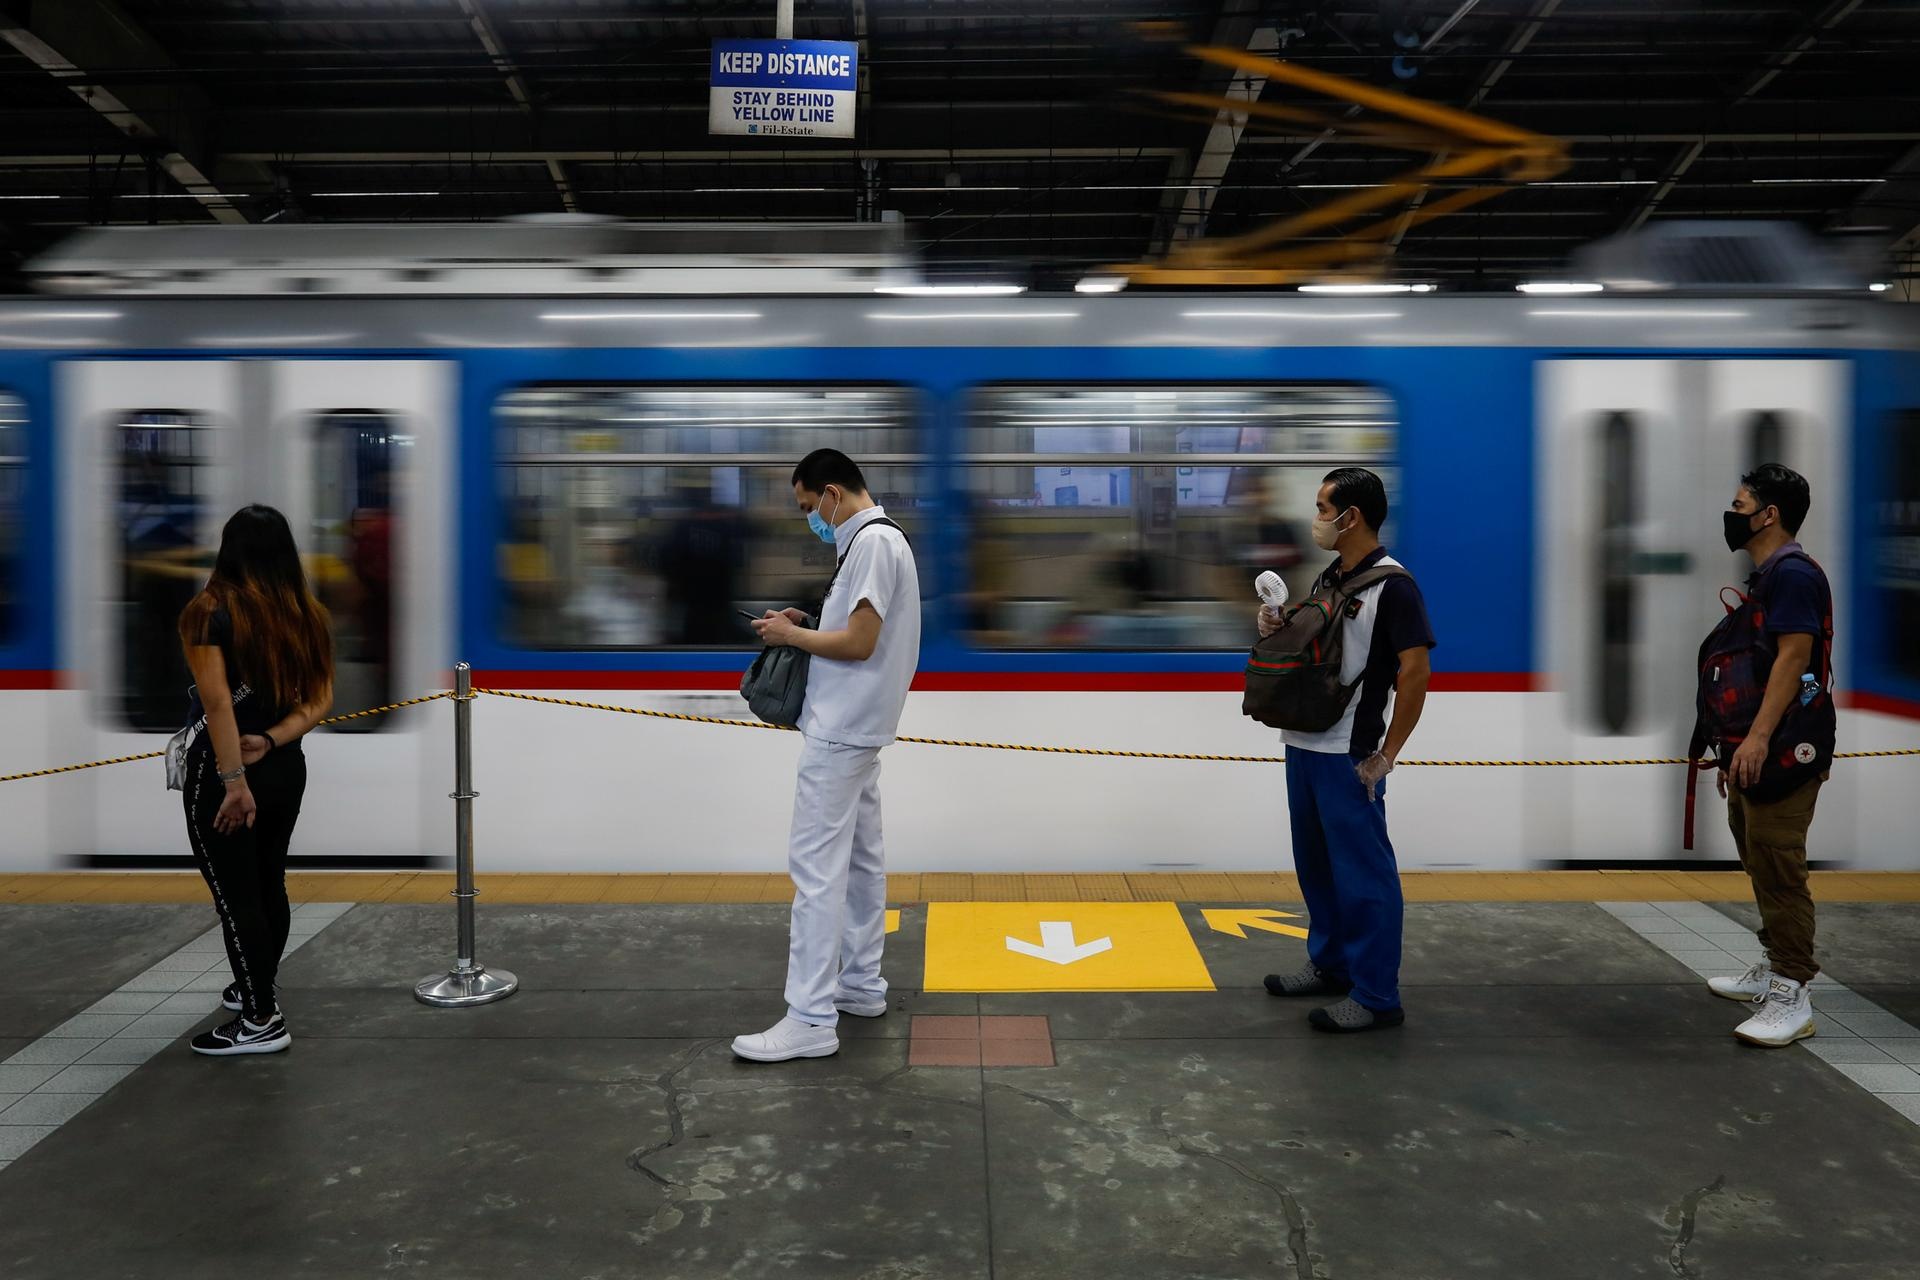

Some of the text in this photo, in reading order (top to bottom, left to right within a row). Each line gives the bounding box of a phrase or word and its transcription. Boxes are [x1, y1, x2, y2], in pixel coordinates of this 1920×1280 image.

[720, 52, 850, 77] KEEP DISTANCE
[733, 91, 834, 107] STAY BEHIND
[732, 107, 834, 123] YELLOW LINE
[762, 125, 814, 135] Fil-Estate
